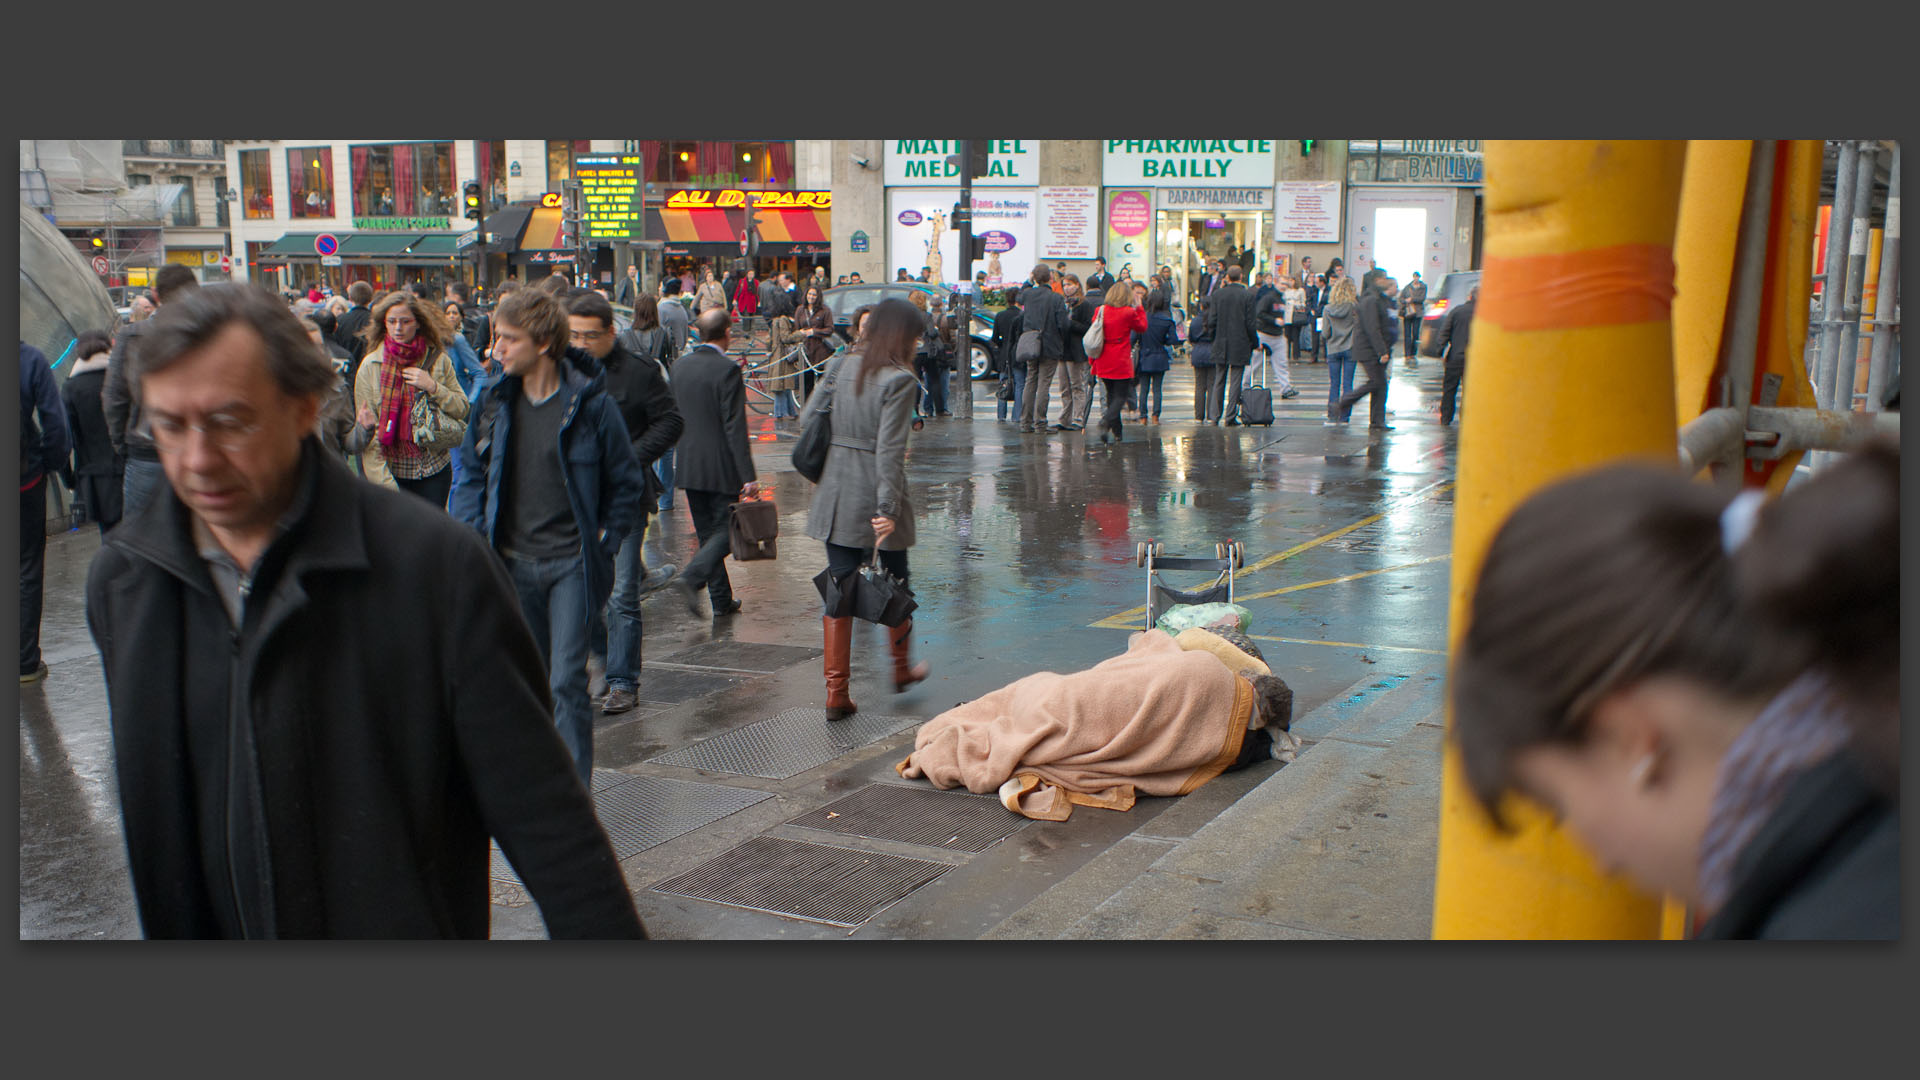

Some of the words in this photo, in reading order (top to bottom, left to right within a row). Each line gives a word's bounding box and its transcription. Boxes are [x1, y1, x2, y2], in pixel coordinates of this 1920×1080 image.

[1108, 140, 1272, 154] PHARMACIE
[904, 159, 1019, 178] MEDAL
[1143, 158, 1233, 178] BAILLY
[1408, 157, 1477, 179] BAILLY
[667, 190, 710, 203] AU
[1167, 190, 1264, 205] PARAPHARMACIE
[412, 217, 450, 229] COFFEE
